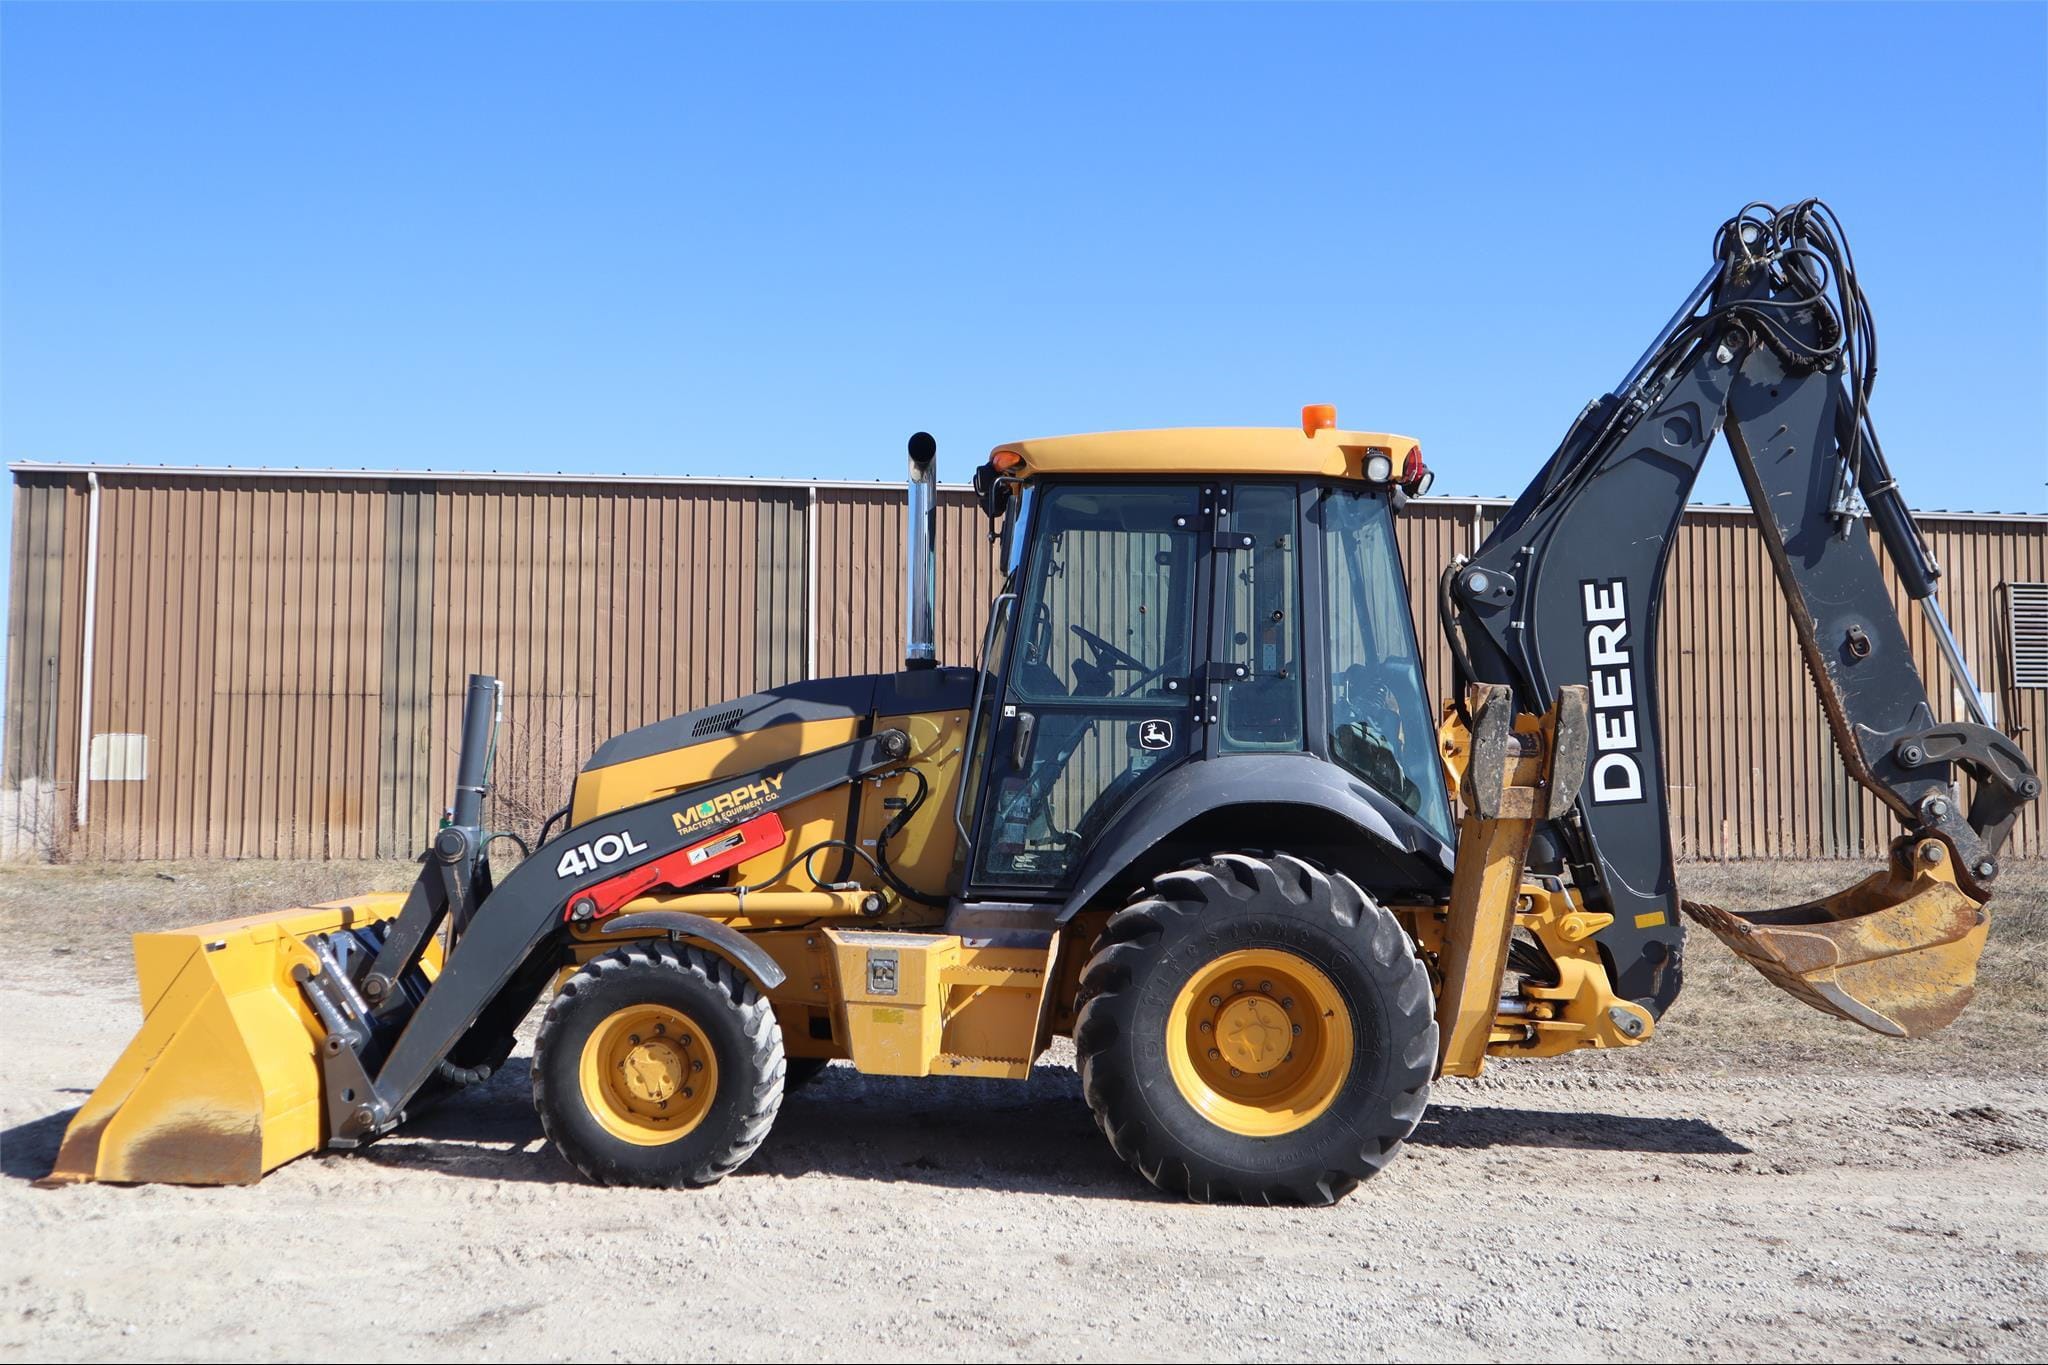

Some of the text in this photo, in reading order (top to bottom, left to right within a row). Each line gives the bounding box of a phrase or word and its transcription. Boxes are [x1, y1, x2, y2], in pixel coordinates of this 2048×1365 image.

[1583, 581, 1643, 803] DEERE
[677, 817, 714, 836] TRACTOR
[721, 798, 765, 820] EQUIPMENT
[556, 830, 648, 878] 410L
